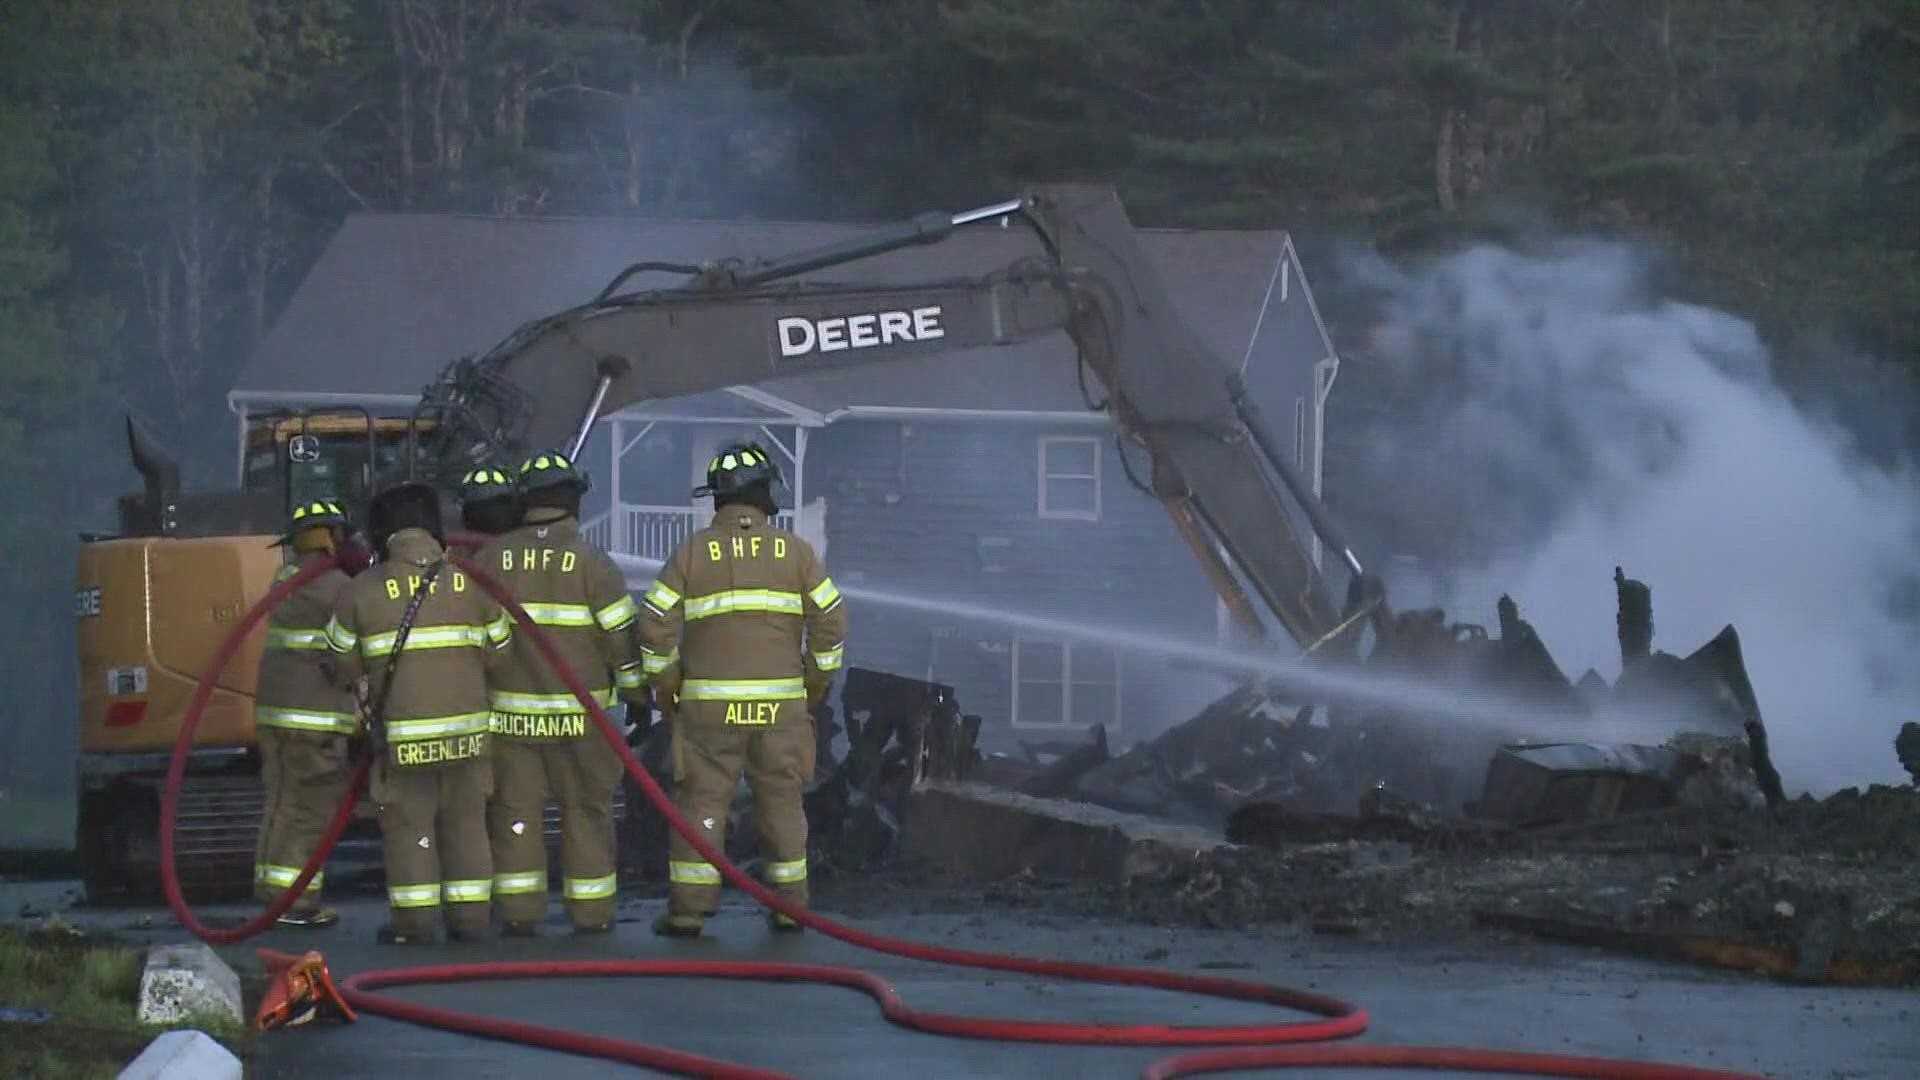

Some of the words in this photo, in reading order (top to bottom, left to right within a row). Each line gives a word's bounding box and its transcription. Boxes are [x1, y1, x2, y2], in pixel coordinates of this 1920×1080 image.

[777, 306, 944, 356] DEERE
[496, 714, 585, 736] BUCHANAN
[725, 703, 779, 724] ALLEY
[397, 735, 484, 765] GREENLEAF
